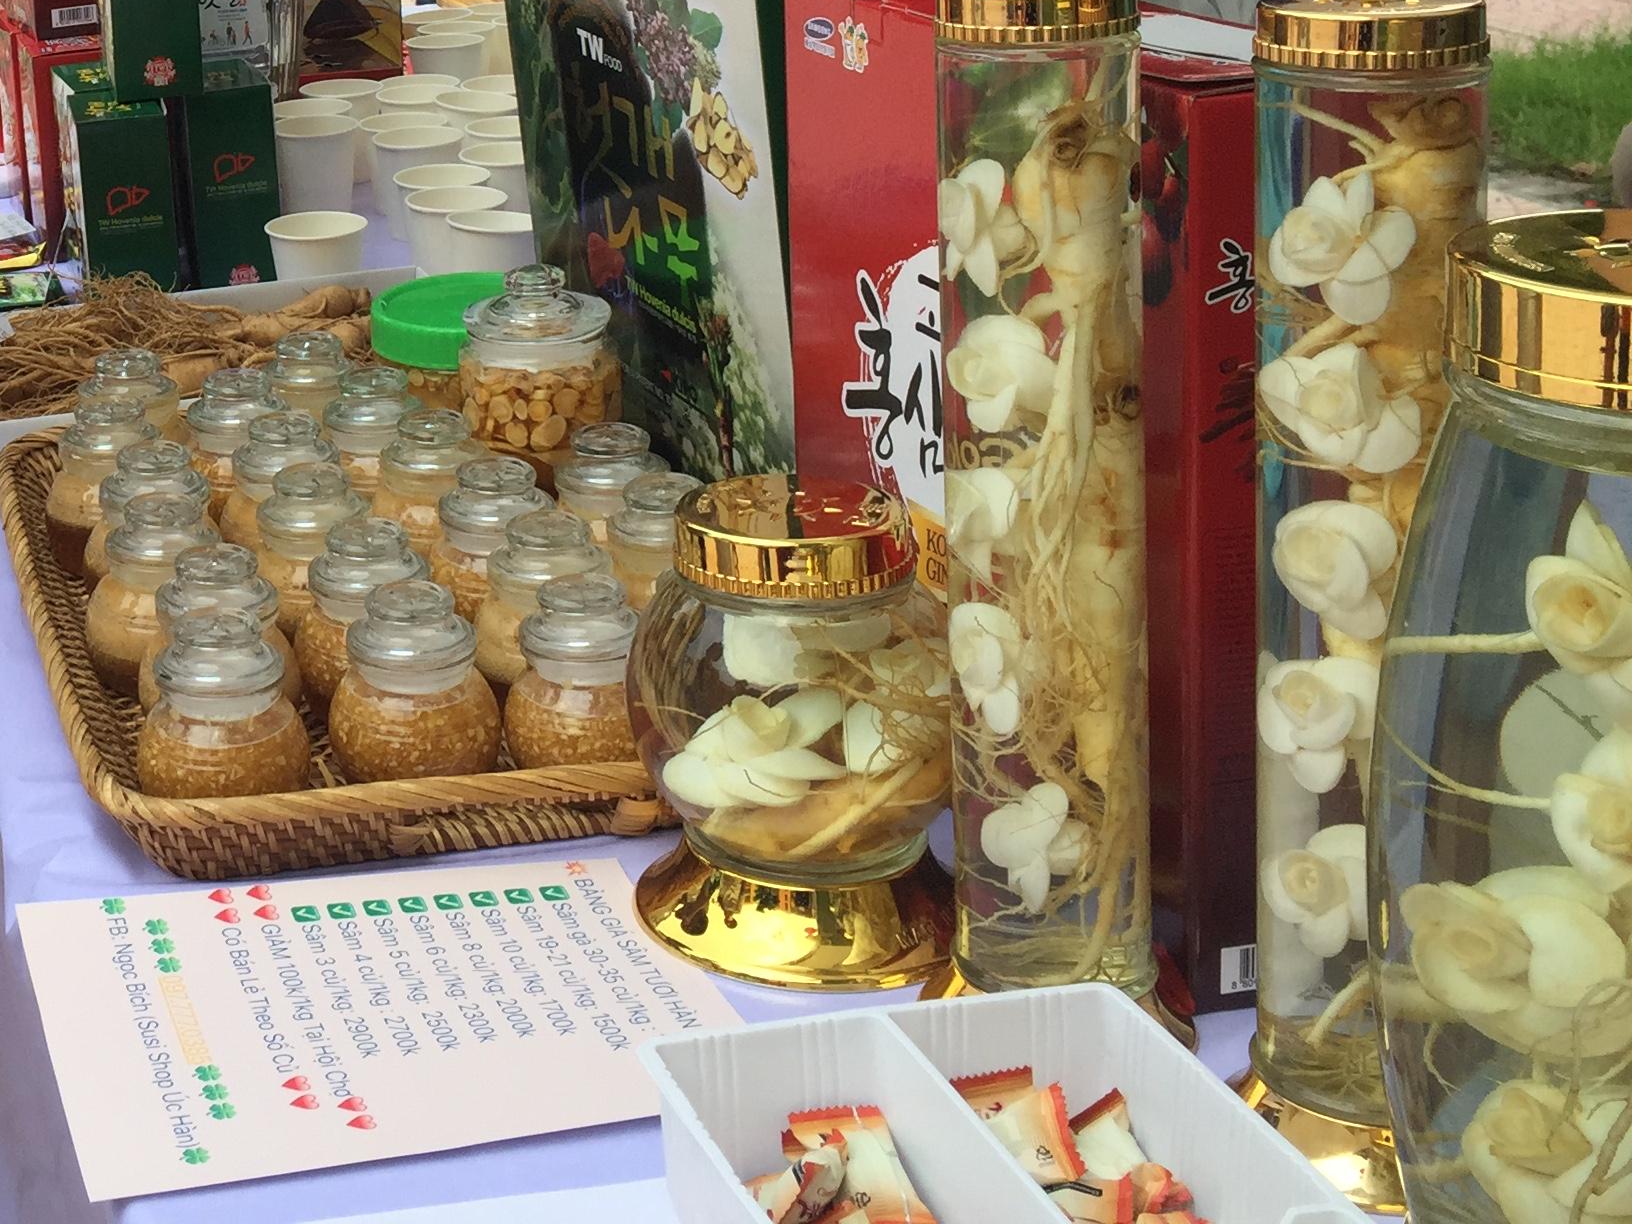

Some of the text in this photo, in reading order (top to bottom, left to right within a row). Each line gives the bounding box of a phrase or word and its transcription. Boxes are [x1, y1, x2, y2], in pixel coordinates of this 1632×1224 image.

[576, 27, 605, 65] TW
[106, 917, 128, 939] FB:
[388, 950, 409, 959] 5
[425, 946, 446, 955] 6
[461, 942, 482, 951] 8
[111, 943, 137, 979] Ngọc
[315, 956, 336, 966] 3
[354, 953, 372, 962] 4
[229, 949, 255, 975] Bán
[249, 995, 274, 1030] Theo
[301, 1022, 330, 1042] Tại
[312, 1044, 342, 1067] Hội
[148, 1051, 174, 1088] Shop
